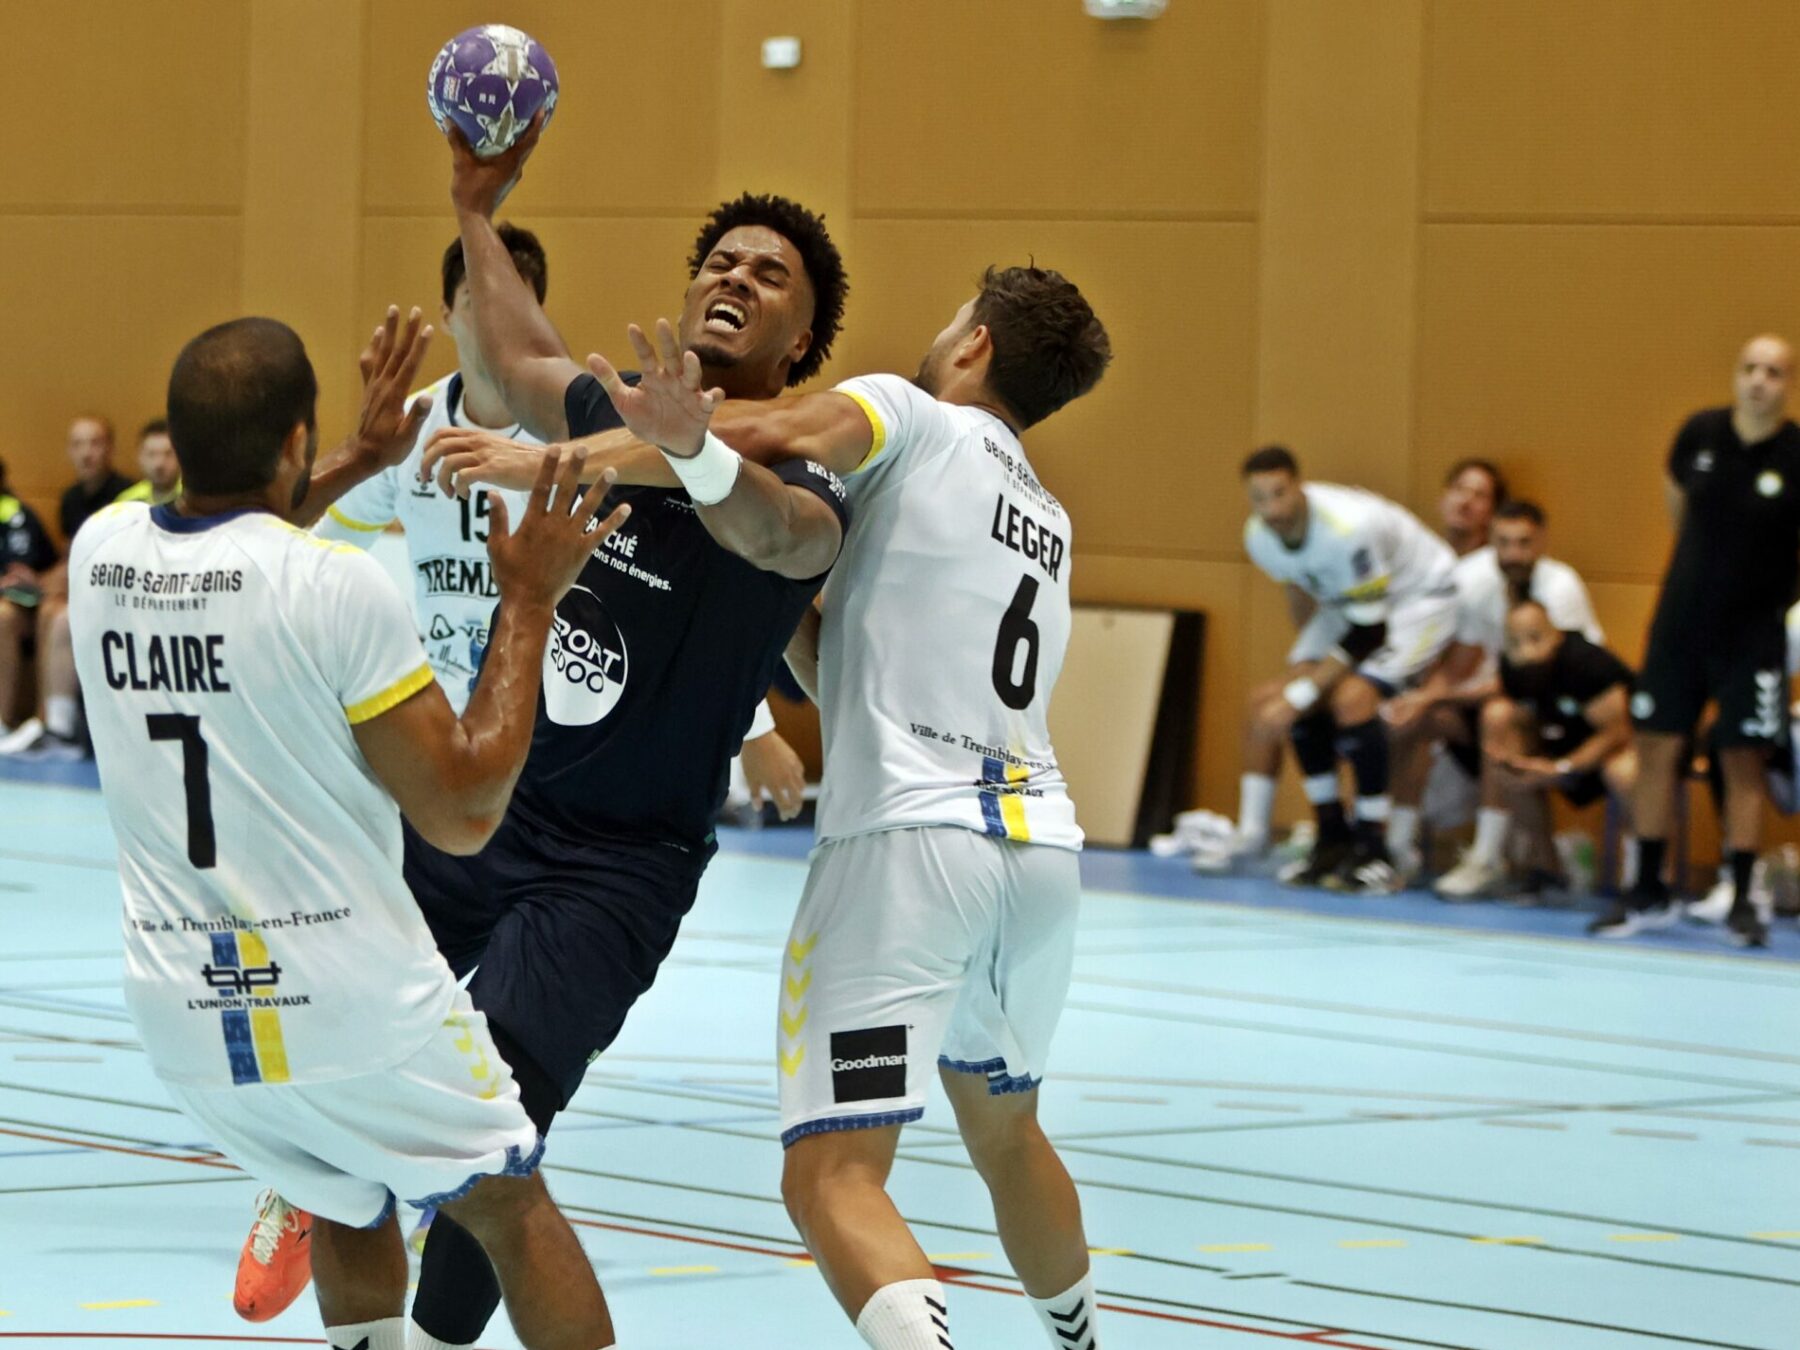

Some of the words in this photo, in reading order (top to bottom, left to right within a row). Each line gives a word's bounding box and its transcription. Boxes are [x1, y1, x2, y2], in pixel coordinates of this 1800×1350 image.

[991, 493, 1064, 583] LEGER
[592, 548, 610, 564] ons
[610, 557, 628, 573] nos
[628, 563, 672, 591] énergies.
[115, 594, 127, 607] LE
[101, 630, 231, 693] CLAIRE
[553, 608, 622, 675] PORT
[992, 573, 1039, 710] 6
[910, 723, 938, 740] Ville
[942, 732, 956, 745] de
[145, 713, 216, 869] 7
[187, 999, 242, 1010] L'UNION
[245, 995, 312, 1008] TRAVAUX
[832, 1053, 909, 1072] Goodman
